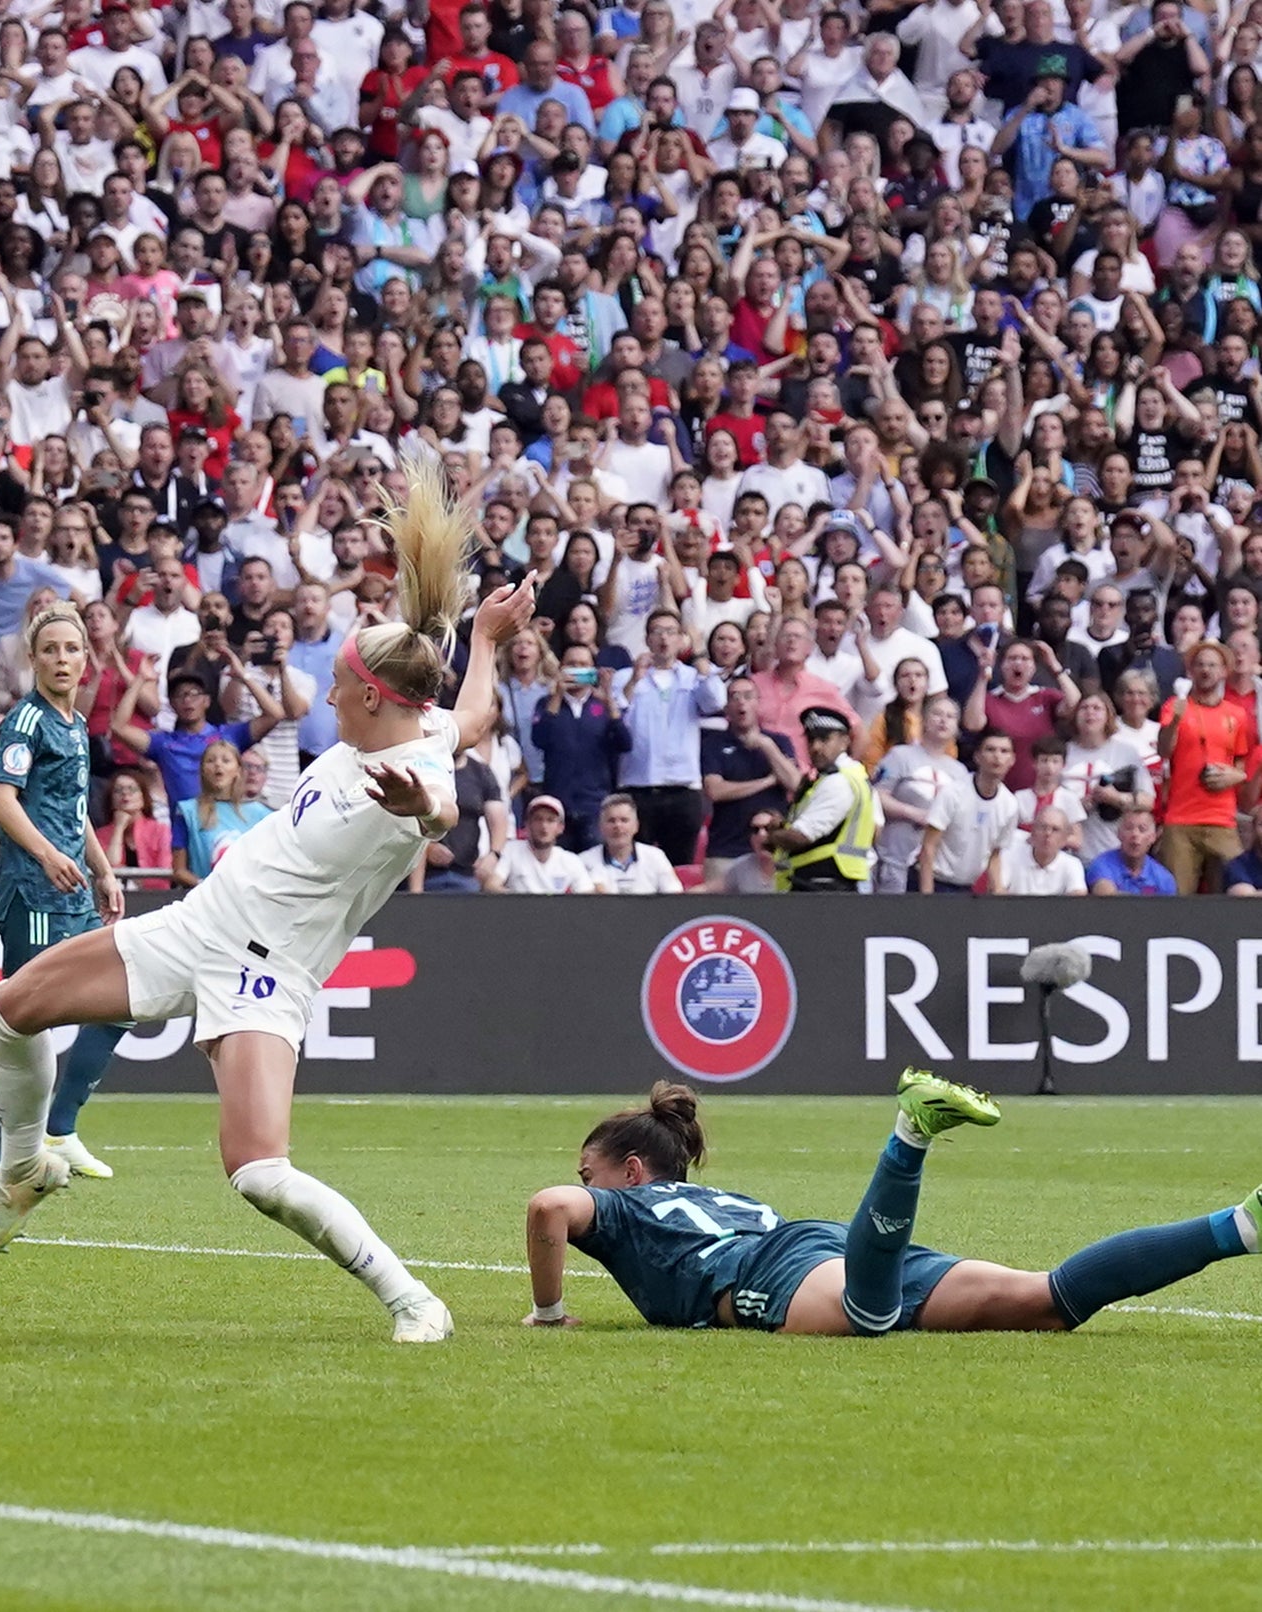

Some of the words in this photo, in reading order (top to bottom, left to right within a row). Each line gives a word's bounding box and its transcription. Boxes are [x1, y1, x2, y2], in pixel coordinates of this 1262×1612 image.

[76, 795, 87, 836] 9
[290, 776, 322, 827] 18
[672, 927, 761, 965] UEFA
